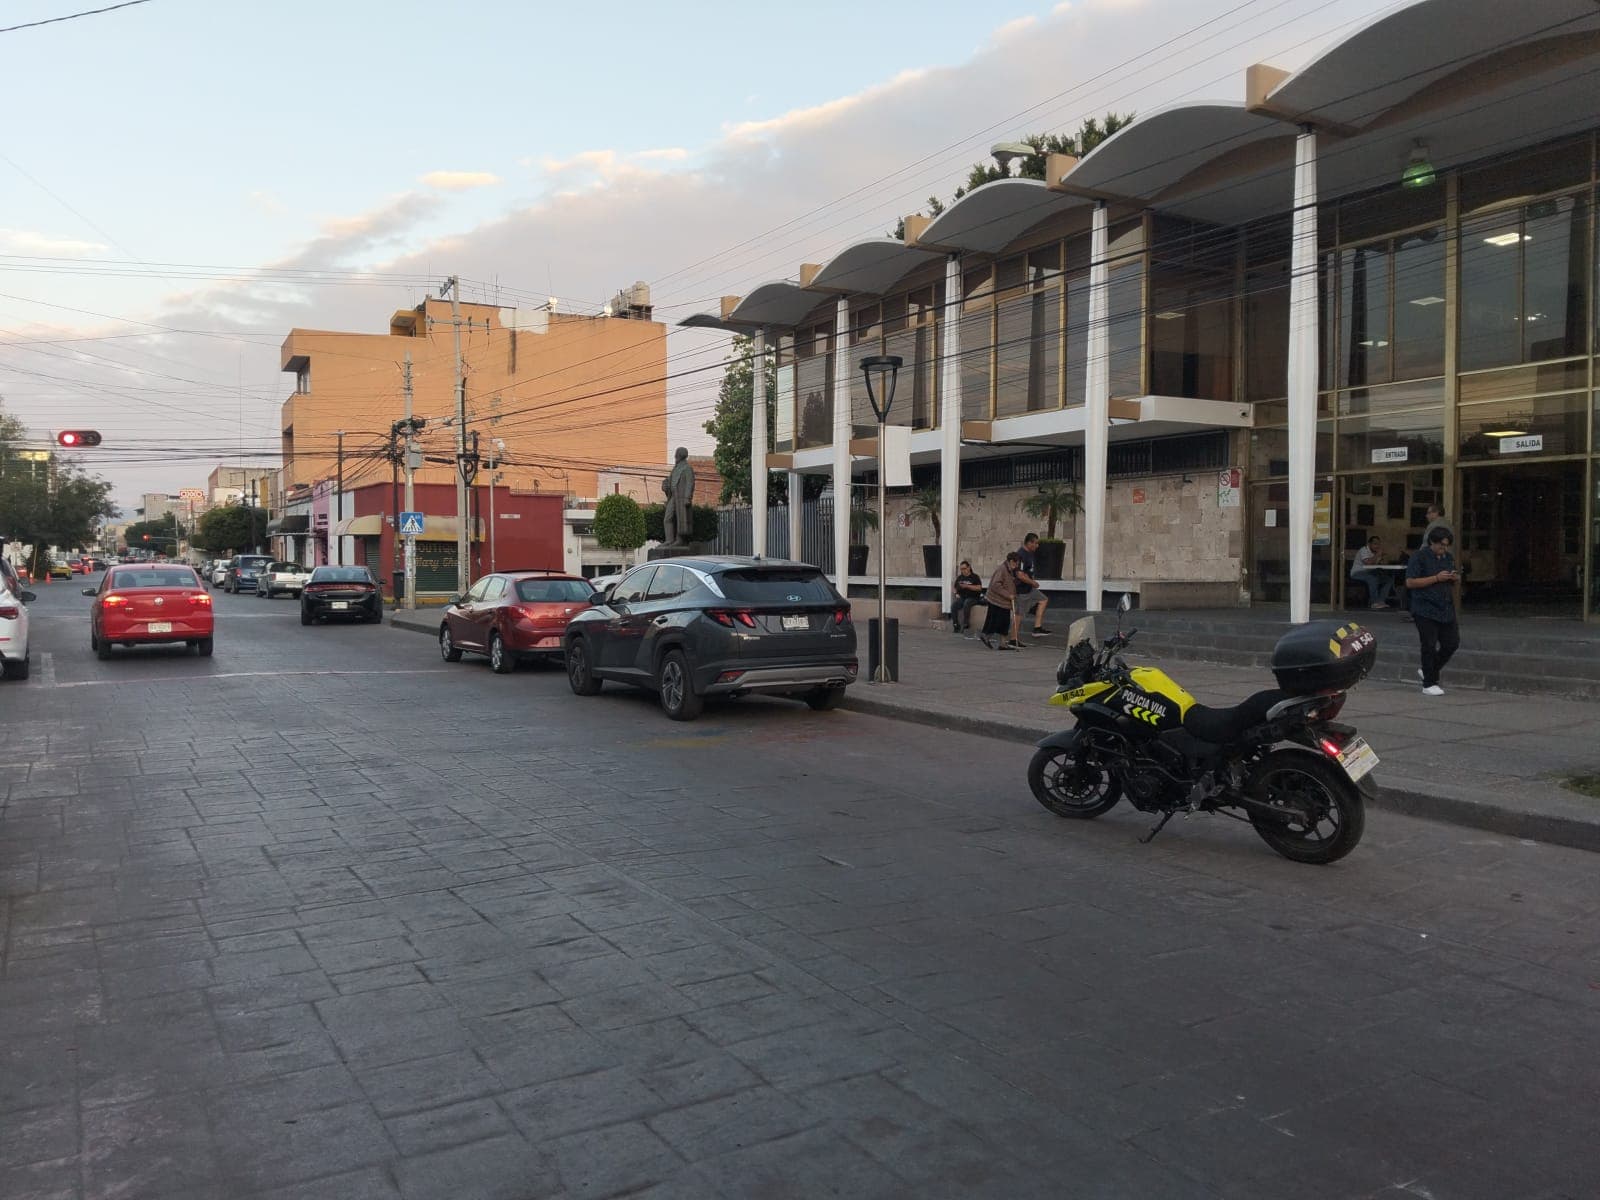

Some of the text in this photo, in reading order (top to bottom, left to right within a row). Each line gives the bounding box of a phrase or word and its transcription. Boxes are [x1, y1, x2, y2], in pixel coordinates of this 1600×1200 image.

[1515, 439, 1541, 449] SALIDA
[1385, 450, 1406, 459] ENTRADA
[1351, 631, 1374, 652] M 542
[1070, 688, 1085, 698] 542
[1121, 689, 1167, 718] POLICIA VIAL
